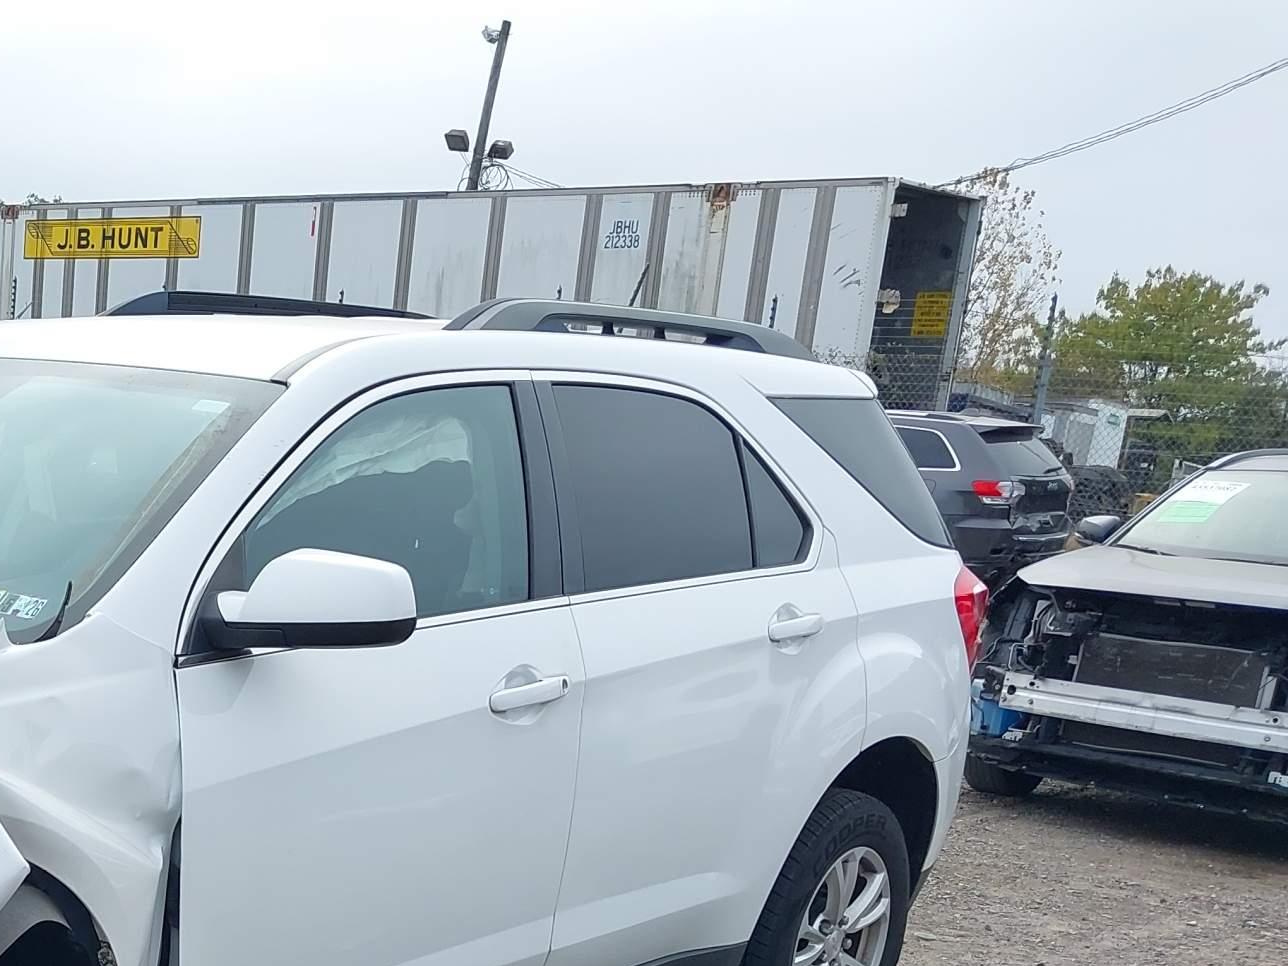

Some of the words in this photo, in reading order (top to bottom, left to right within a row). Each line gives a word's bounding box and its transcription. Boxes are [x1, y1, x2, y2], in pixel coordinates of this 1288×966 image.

[609, 220, 639, 235] JBHU
[101, 226, 164, 249] HUNT
[603, 234, 640, 249] 212338
[25, 599, 45, 617] 26
